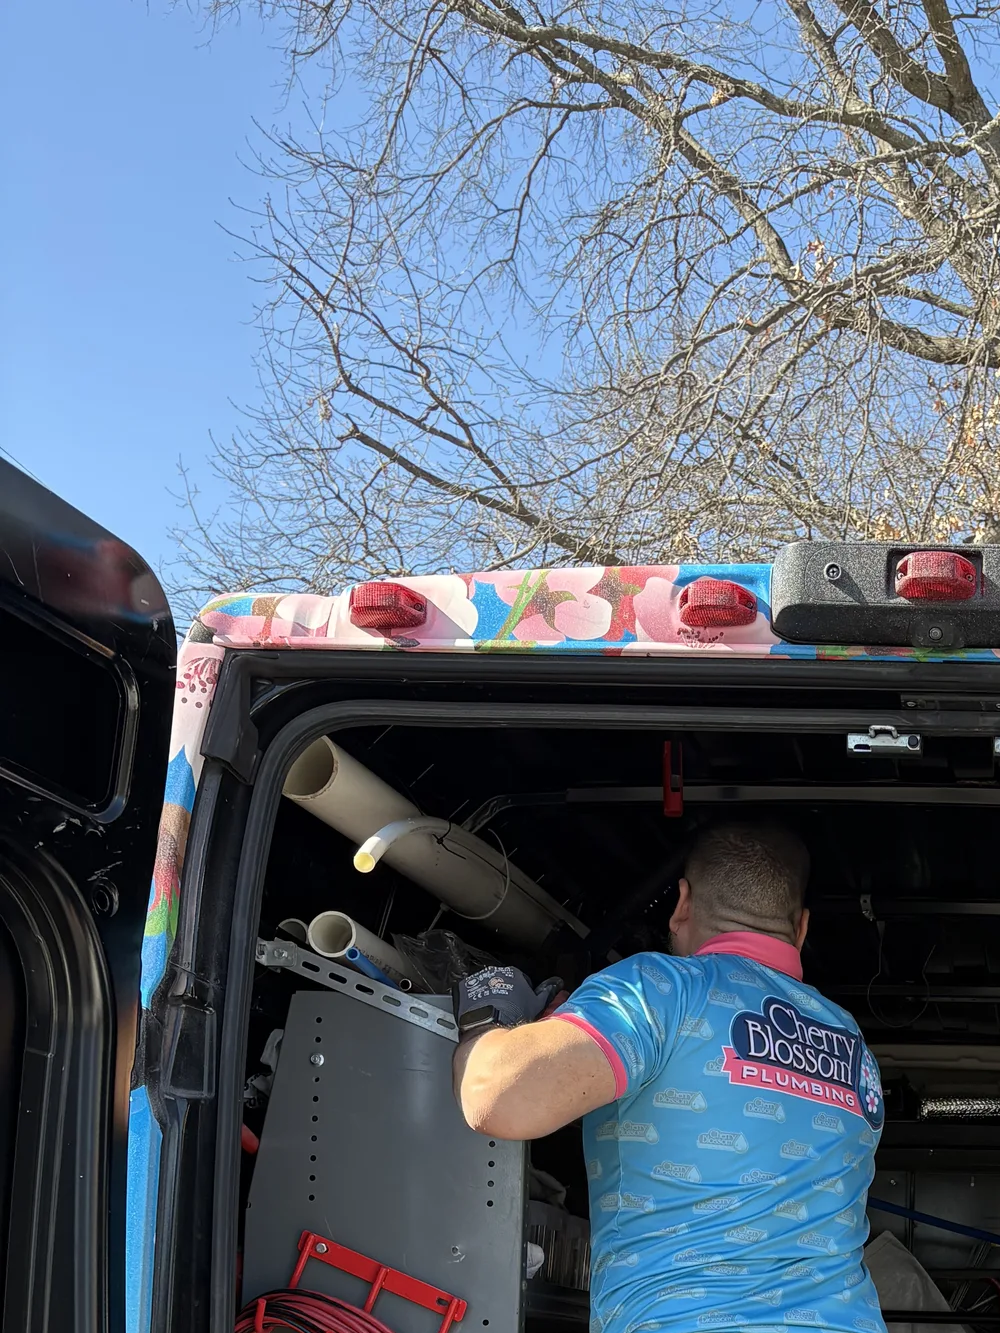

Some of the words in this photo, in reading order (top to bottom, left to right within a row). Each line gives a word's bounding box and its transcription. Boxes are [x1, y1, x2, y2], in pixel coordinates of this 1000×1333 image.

[744, 1019, 853, 1086] Blossom
[769, 1003, 857, 1073] Cherry
[742, 1065, 855, 1107] PLUMBING
